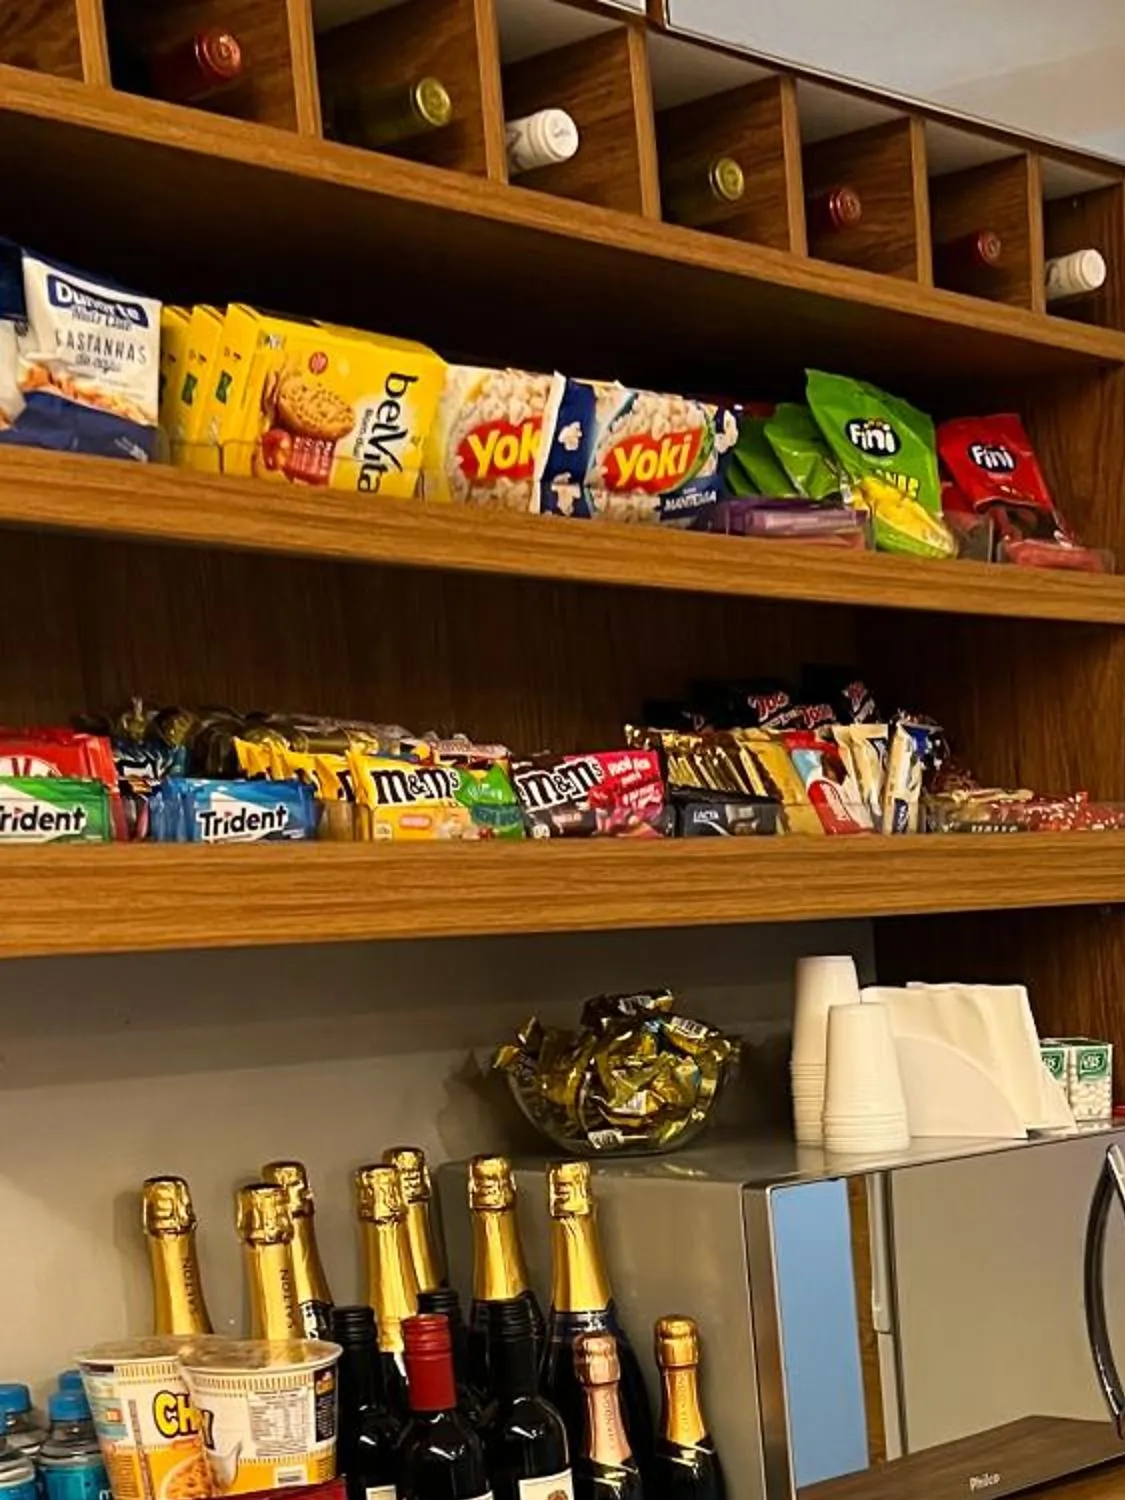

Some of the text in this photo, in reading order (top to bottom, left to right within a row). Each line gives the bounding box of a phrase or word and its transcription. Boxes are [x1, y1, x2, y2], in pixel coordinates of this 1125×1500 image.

[467, 420, 541, 479] Yok
[848, 422, 897, 453] Fini
[614, 431, 694, 488] Yoki
[970, 443, 1015, 470] Fini
[199, 804, 288, 838] Trident
[969, 1472, 1001, 1493] Philco
